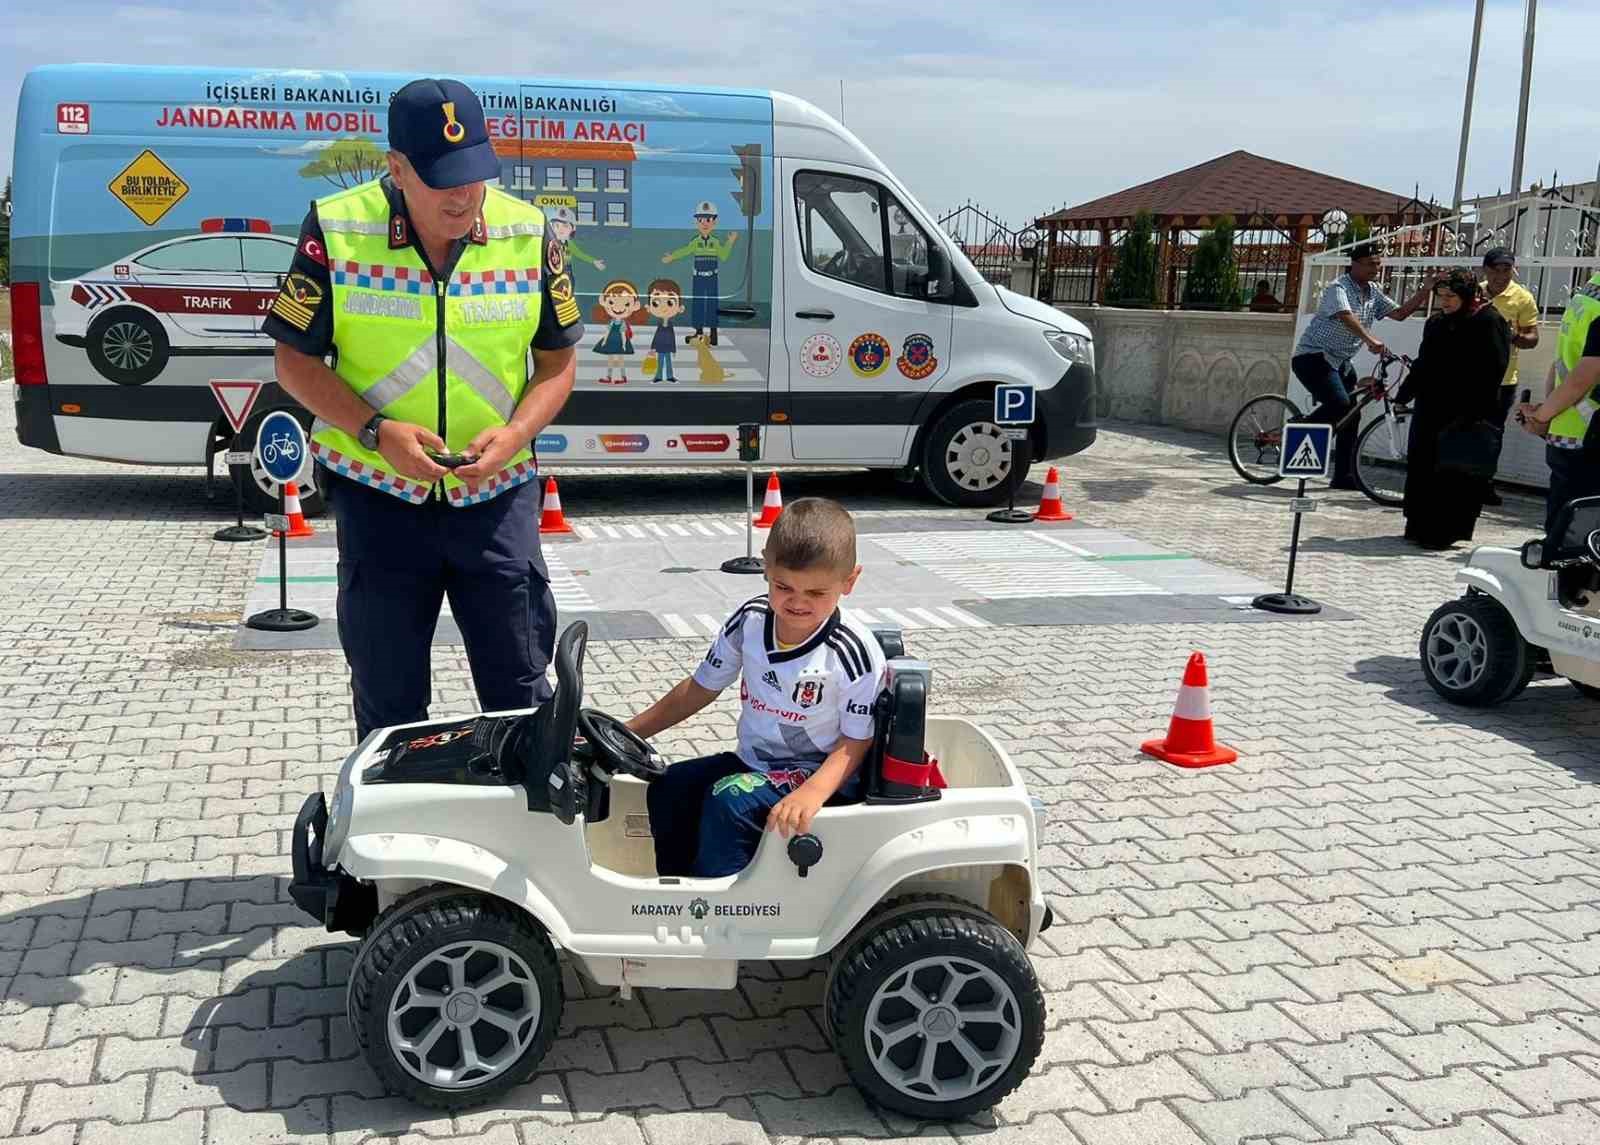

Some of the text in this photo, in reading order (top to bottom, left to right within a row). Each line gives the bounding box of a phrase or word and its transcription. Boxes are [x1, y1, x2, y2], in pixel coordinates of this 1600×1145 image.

[206, 82, 276, 105] İÇİŞLERİ
[284, 86, 381, 104] BAKANLIĞI
[524, 95, 617, 113] BAKANLIĞI
[61, 106, 85, 122] 112
[156, 107, 297, 130] JANDARMA
[305, 109, 382, 133] MOBİL
[574, 121, 646, 142] ARACI
[126, 175, 140, 185] BU
[141, 176, 170, 186] YOLDA
[541, 196, 570, 205] OKUL
[1004, 389, 1025, 419] P
[631, 902, 781, 916] KARATAY BELEDİYESİ
